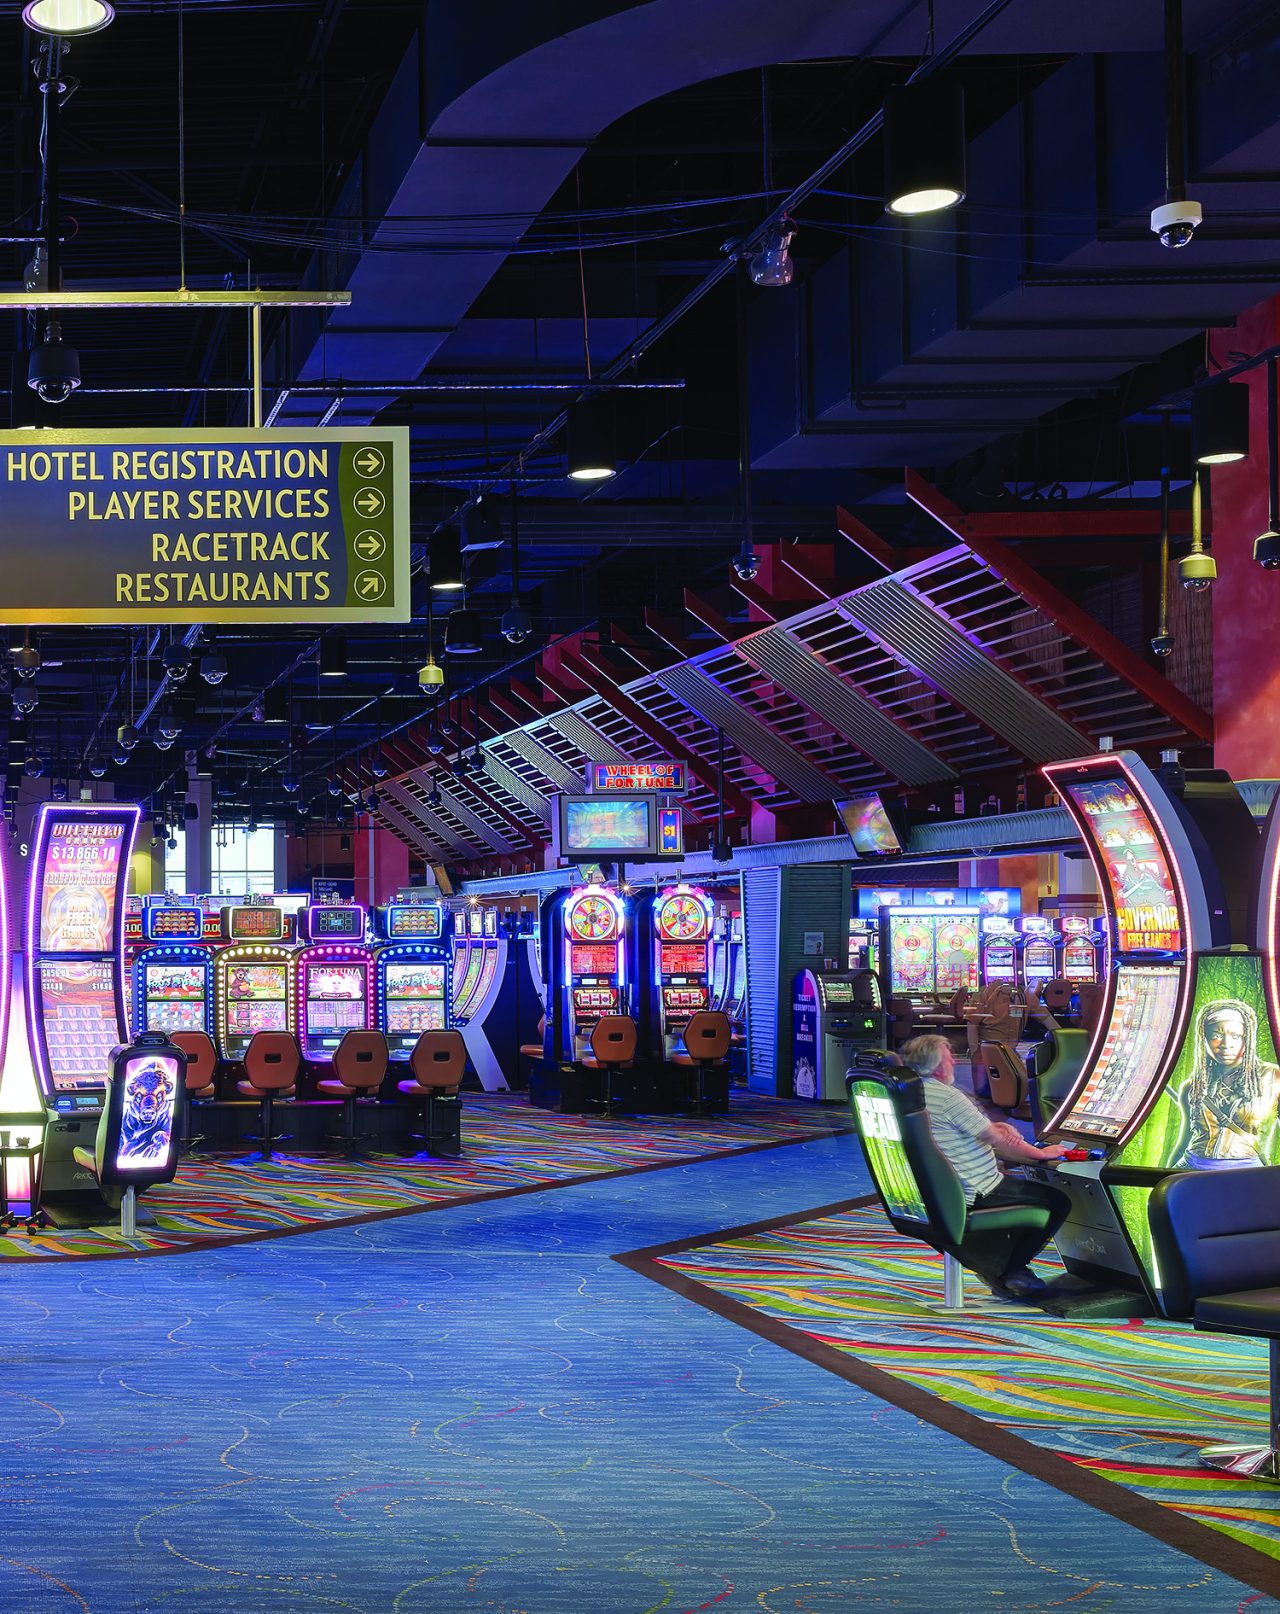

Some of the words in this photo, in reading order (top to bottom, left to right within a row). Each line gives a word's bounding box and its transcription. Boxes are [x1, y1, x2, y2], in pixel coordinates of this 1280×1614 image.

[7, 451, 104, 481] HOTEL
[112, 449, 328, 480] REGISTRATION
[69, 491, 180, 521] PLAYER
[187, 488, 330, 520] SERVICES
[152, 531, 330, 562] RACETRACK
[116, 571, 330, 602] RESTAURANTS
[606, 765, 654, 776] WHEEL
[655, 765, 674, 776] OF
[606, 777, 675, 789] FORTUNE
[664, 825, 676, 837] $1
[65, 838, 106, 846] GRAND
[1116, 904, 1180, 931] GOVERNOR
[1128, 932, 1144, 948] FREE
[1145, 933, 1171, 949] GAMES
[309, 968, 364, 980] FORTUNA
